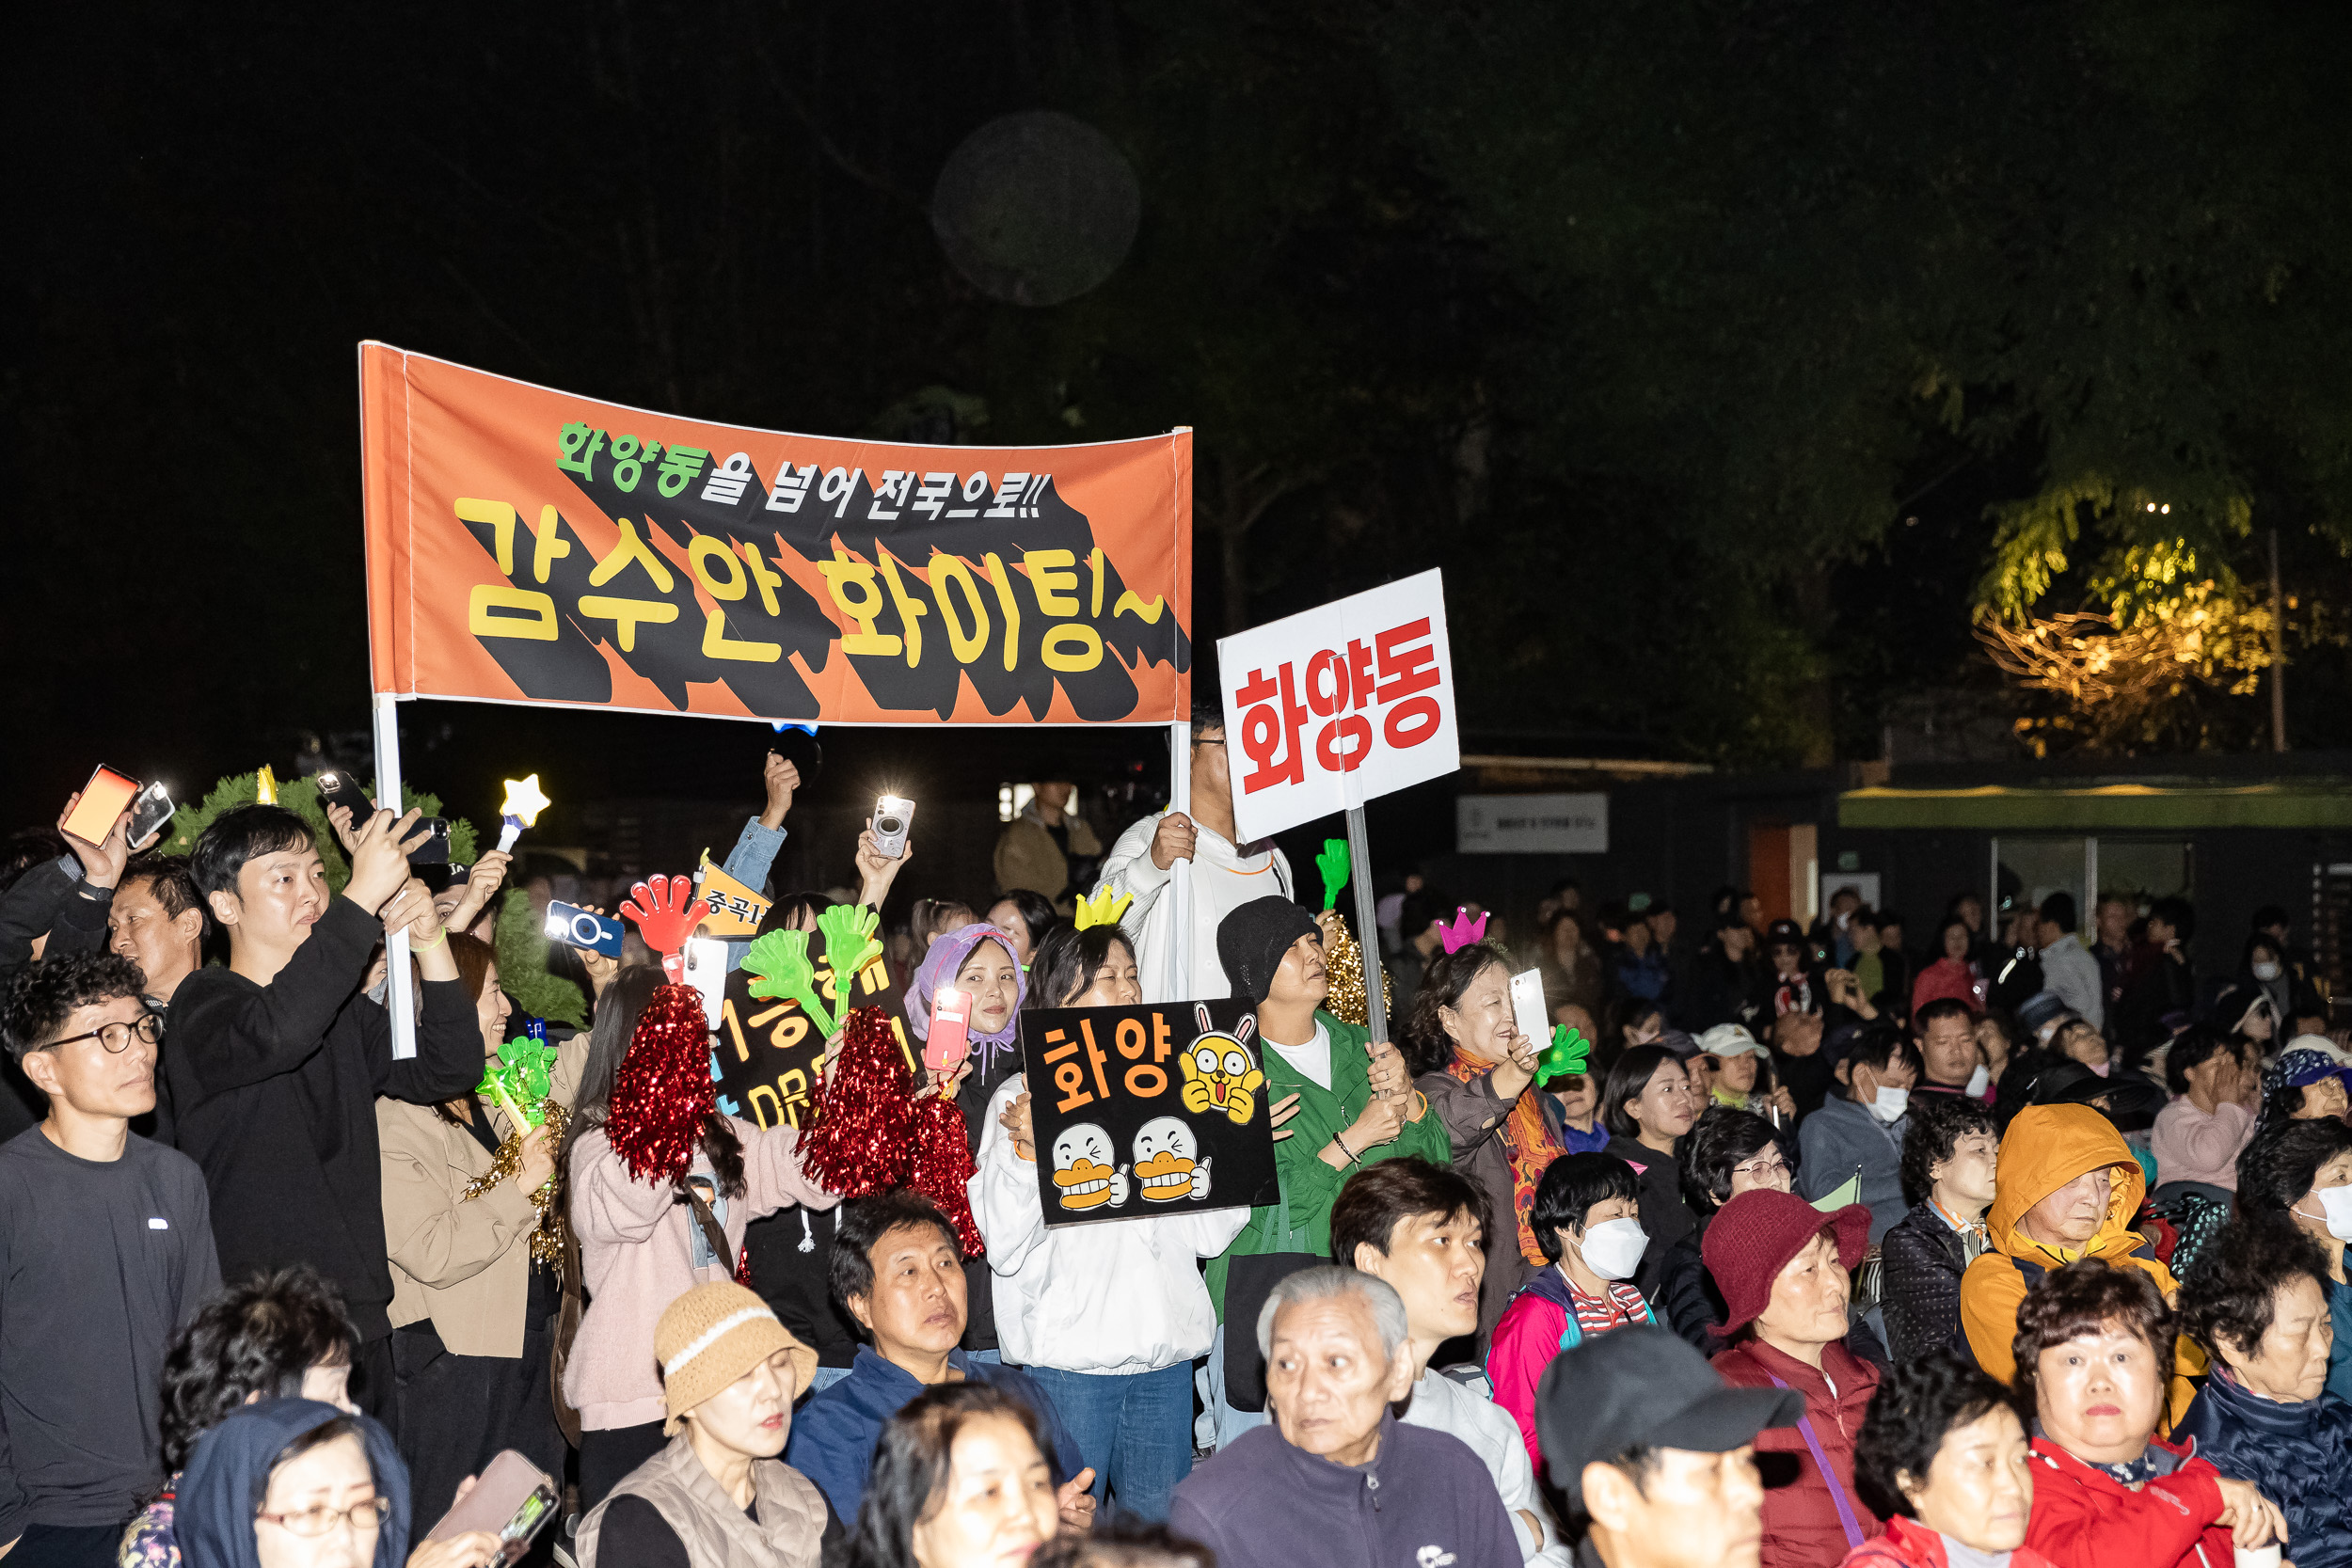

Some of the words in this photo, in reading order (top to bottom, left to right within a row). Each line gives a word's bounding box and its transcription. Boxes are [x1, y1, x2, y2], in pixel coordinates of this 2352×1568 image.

[555, 420, 754, 507] 화양동을
[765, 460, 863, 519] 넘어
[866, 469, 1052, 521] 전국으로!!
[453, 497, 784, 664] 감수안
[1234, 615, 1441, 796] 화양동
[706, 889, 770, 926] 중곡1
[1042, 1011, 1172, 1115] 화양
